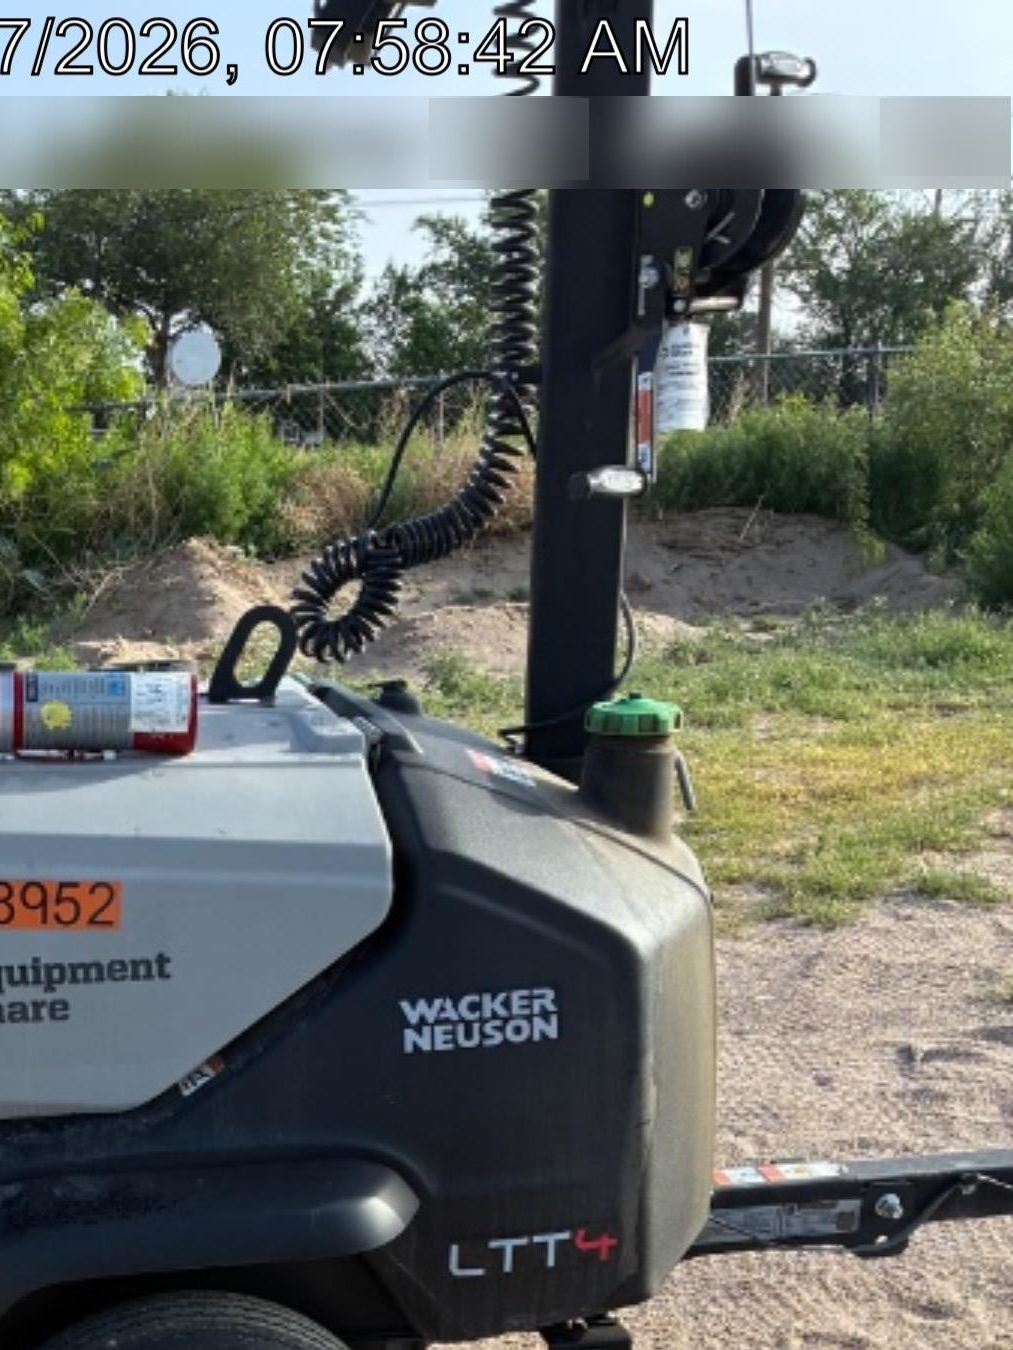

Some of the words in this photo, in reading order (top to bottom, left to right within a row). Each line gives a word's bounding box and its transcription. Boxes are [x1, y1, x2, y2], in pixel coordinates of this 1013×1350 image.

[399, 985, 558, 1025] WACKER
[403, 1013, 559, 1054] NEUSON
[448, 1227, 618, 1277] LTT4
